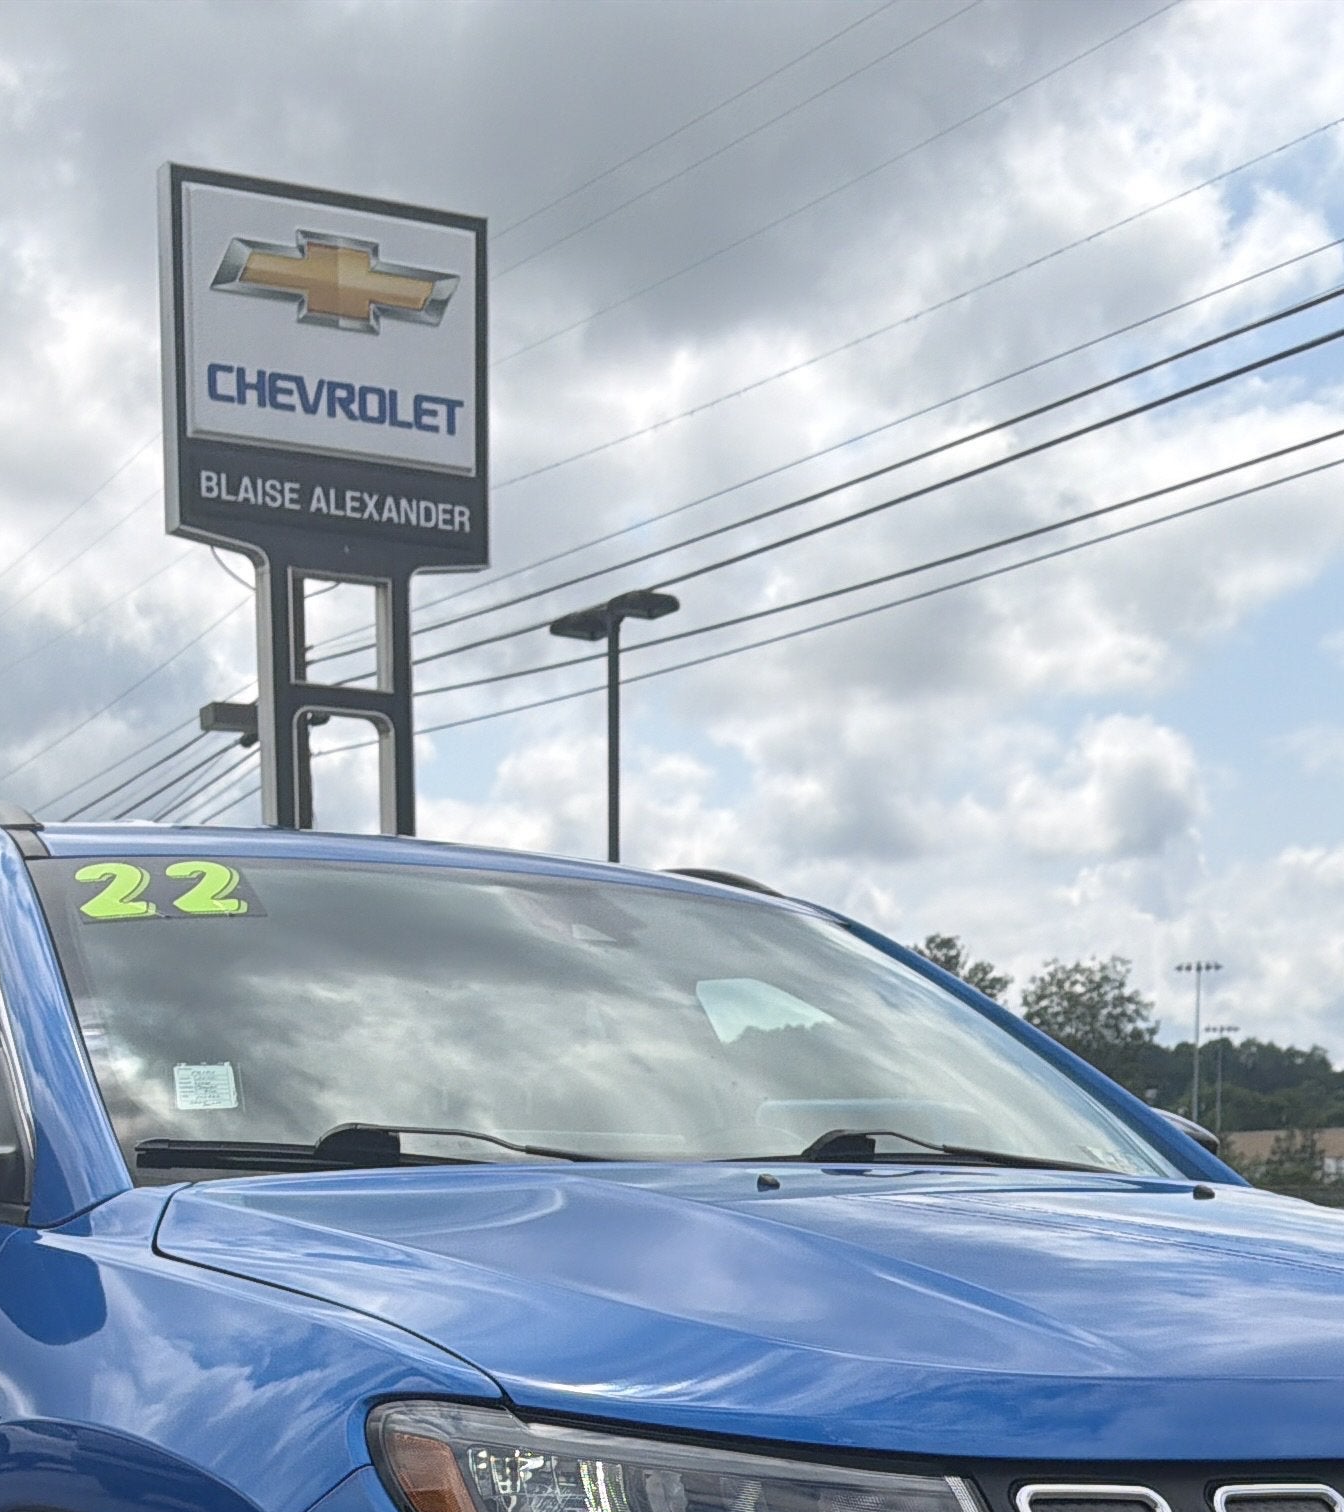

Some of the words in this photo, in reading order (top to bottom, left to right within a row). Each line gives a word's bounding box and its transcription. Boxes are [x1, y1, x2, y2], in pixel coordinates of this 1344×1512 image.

[206, 363, 464, 436] CHEVROLET
[199, 470, 301, 510] BLAISE
[309, 485, 471, 533] ALEXANDER
[74, 861, 248, 919] 22
